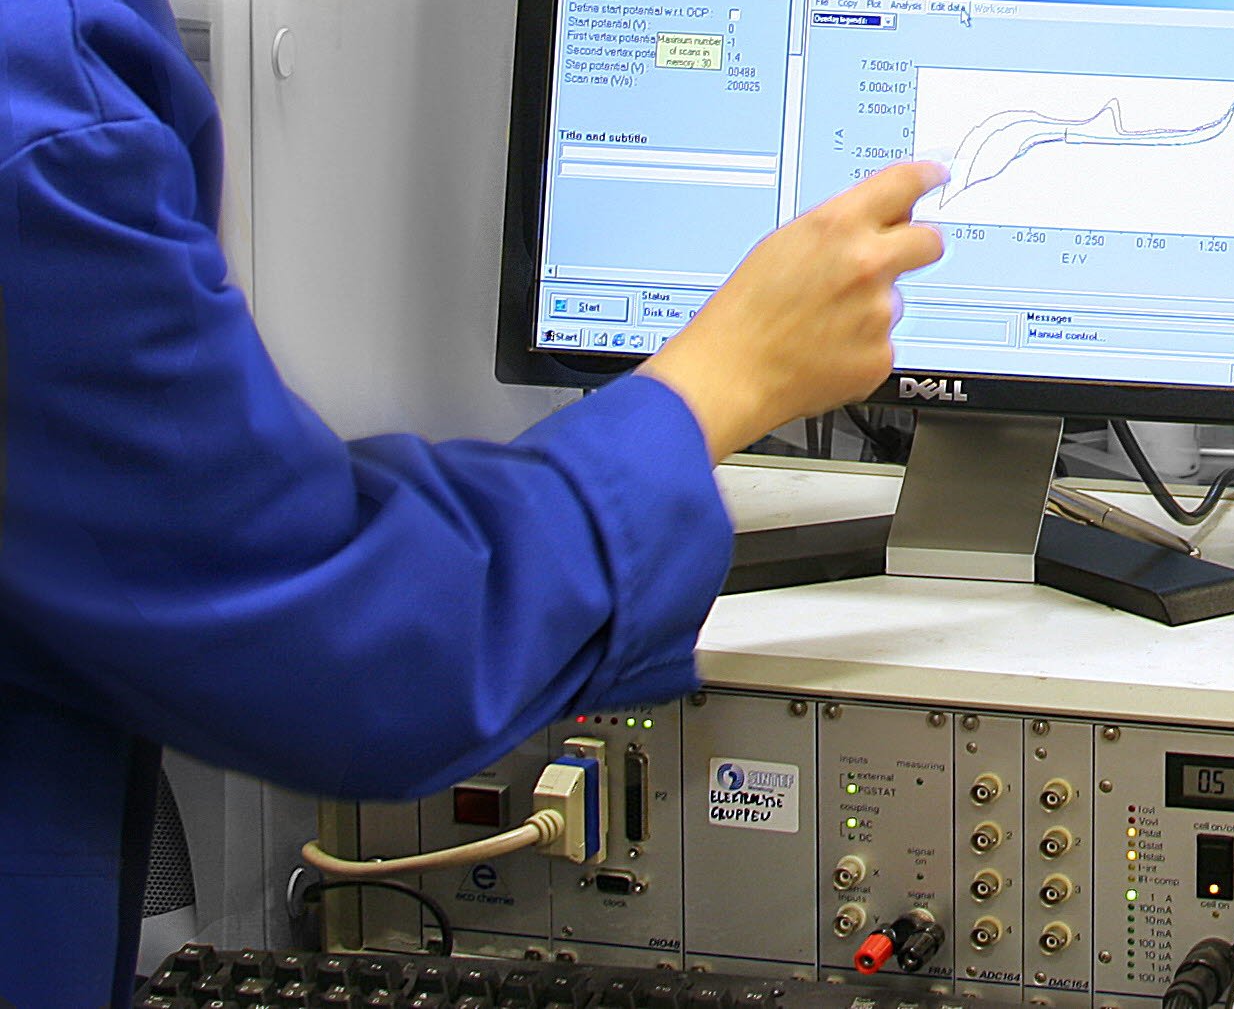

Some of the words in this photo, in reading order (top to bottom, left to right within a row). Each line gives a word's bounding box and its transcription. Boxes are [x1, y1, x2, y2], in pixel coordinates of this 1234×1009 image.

[569, 2, 599, 13] Define
[601, 4, 622, 15] start
[623, 6, 662, 17] potential
[866, 0, 882, 9] Plot
[890, 0, 922, 12] Analysis
[930, 2, 946, 12] Edit
[947, 3, 966, 13] data
[568, 17, 590, 28] Start
[591, 18, 631, 30] potential
[567, 30, 587, 41] First
[693, 37, 722, 47] number
[566, 45, 603, 56] Second
[565, 59, 588, 72] Step
[589, 61, 629, 73] potential
[564, 73, 589, 84] Scan
[590, 75, 609, 85] rate
[559, 129, 582, 141] Title
[585, 131, 606, 142] and
[609, 132, 648, 144] subtitle
[902, 127, 909, 138] 0
[952, 228, 985, 241] -0.750
[1012, 231, 1046, 244] -0.250
[1075, 234, 1105, 247] 0.250
[1136, 237, 1166, 249] 0.750
[1199, 240, 1228, 252] 1.250
[642, 291, 670, 301] Status
[578, 302, 601, 313] Start
[643, 307, 662, 318] Disk
[1027, 312, 1072, 324] Messages
[555, 332, 578, 343] Start
[1029, 329, 1063, 340] Manual
[899, 376, 968, 402] DELL
[840, 754, 869, 766] inputs
[896, 760, 945, 772] measuring
[857, 772, 895, 782] external
[858, 786, 896, 797] PGSTAT
[840, 803, 880, 815] coupling
[859, 820, 873, 829] AC
[1193, 822, 1209, 831] cell
[859, 833, 873, 842] DC
[907, 847, 935, 858] signal
[915, 857, 927, 865] on
[838, 893, 867, 904] inputs
[907, 891, 936, 901] signal
[913, 901, 929, 909] out
[1200, 900, 1215, 909] cell
[1218, 902, 1230, 910] on
[979, 970, 1021, 982] ADC164
[1048, 978, 1089, 989] DAC164
